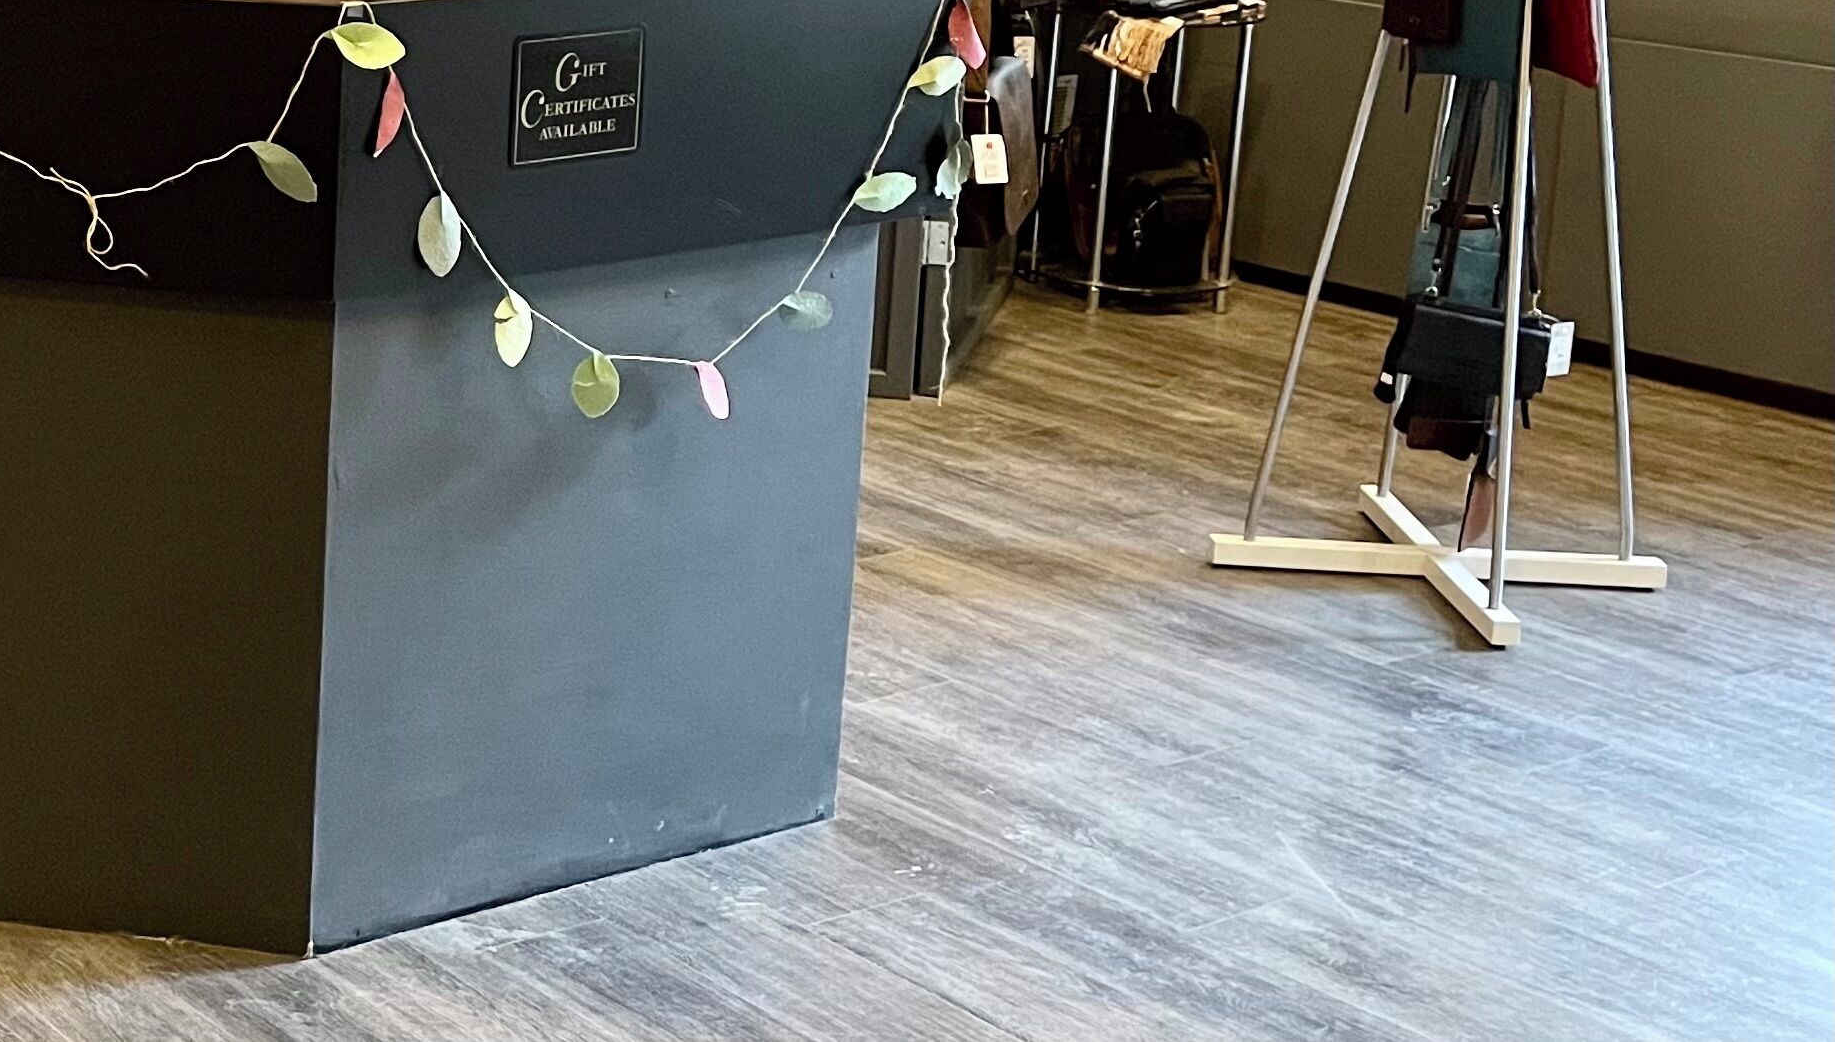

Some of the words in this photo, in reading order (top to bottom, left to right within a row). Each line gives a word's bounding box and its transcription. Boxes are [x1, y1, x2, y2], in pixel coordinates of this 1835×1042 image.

[555, 52, 608, 92] GIFT
[521, 89, 636, 129] CERTIFICATES
[538, 118, 617, 141] AVAILABLE
